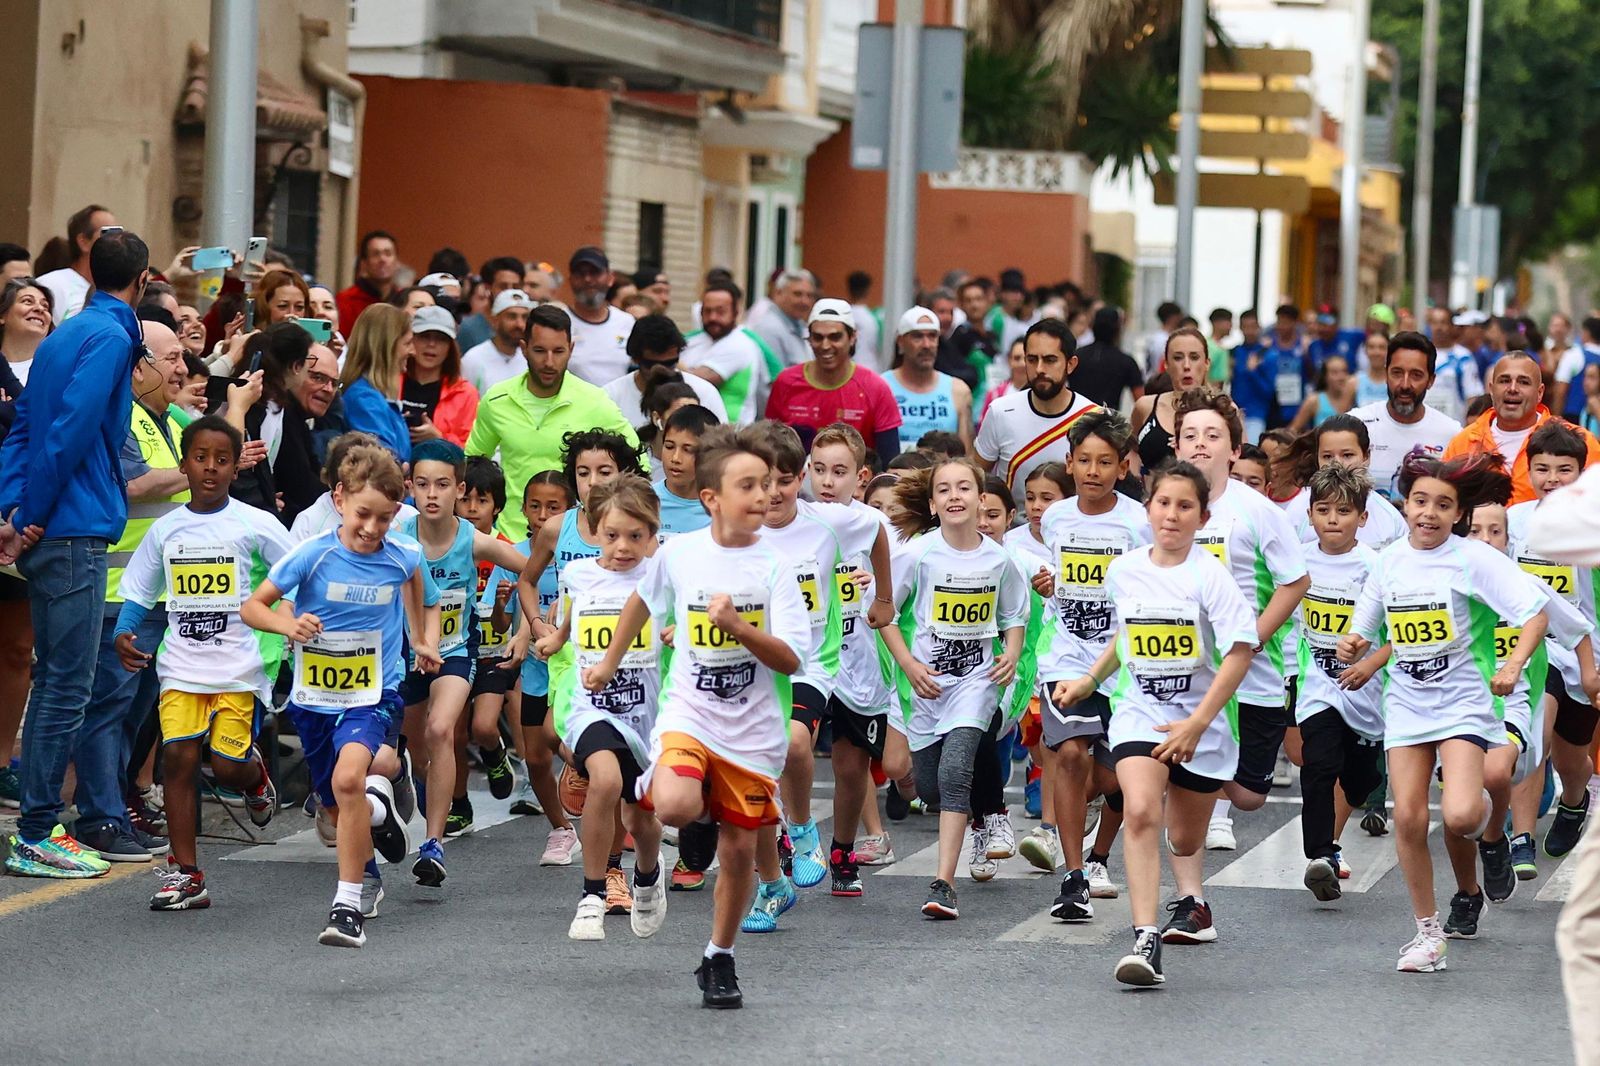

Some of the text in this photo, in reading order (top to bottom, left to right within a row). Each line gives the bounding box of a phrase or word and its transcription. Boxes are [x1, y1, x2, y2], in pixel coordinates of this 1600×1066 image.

[1066, 562, 1105, 584] 104
[176, 573, 231, 595] 1029
[344, 585, 378, 604] RULES
[1541, 575, 1570, 594] 72
[937, 602, 990, 623] 1060
[1306, 607, 1349, 633] 1017
[180, 619, 224, 636] EL PALO
[1065, 616, 1107, 631] EL PALO
[1393, 619, 1448, 643] 1033
[583, 627, 646, 649] 101
[1133, 635, 1194, 657] 1049
[308, 664, 371, 690] 1024
[939, 660, 955, 673] EL
[700, 668, 752, 689] EL PALO
[1153, 677, 1187, 693] PALO
[594, 689, 641, 708] EL PALO
[866, 719, 878, 745] 9
